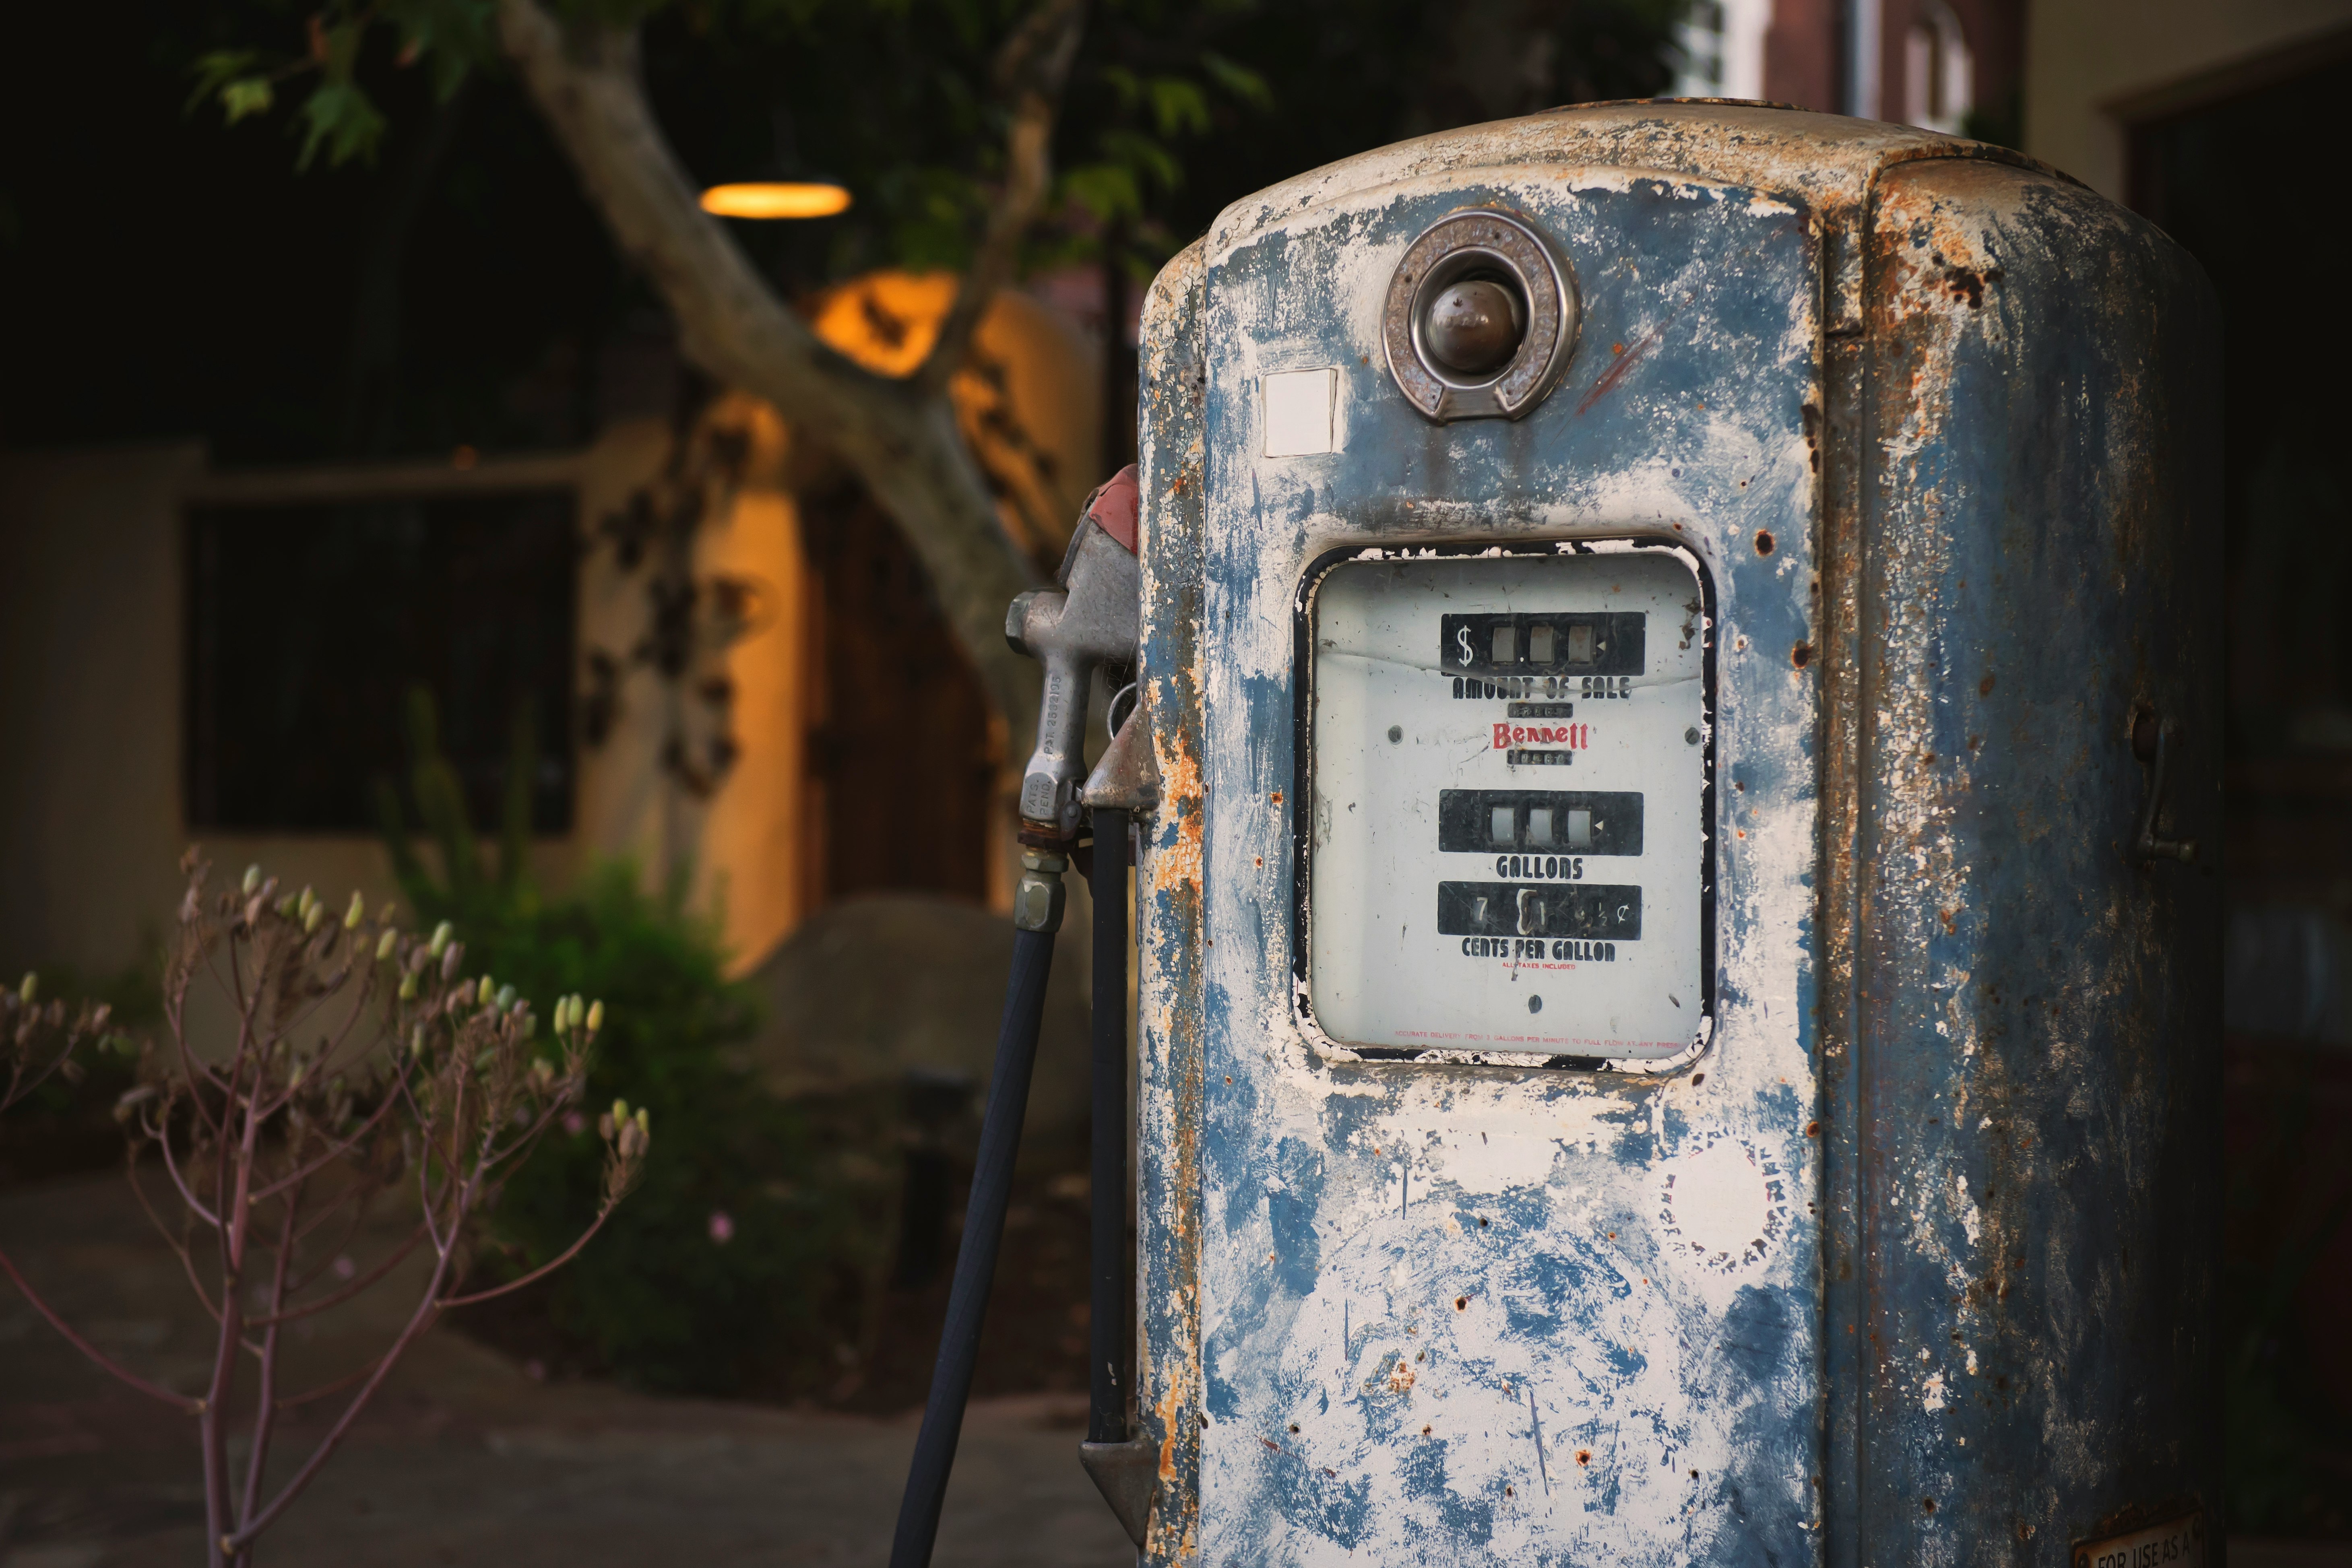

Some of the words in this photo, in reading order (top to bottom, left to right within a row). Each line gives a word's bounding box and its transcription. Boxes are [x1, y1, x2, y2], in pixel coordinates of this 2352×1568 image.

[1457, 625, 1473, 667] $
[1453, 677, 1534, 699] AMOUNT
[1545, 677, 1569, 699] OF
[1582, 677, 1630, 699] SALE
[1044, 731, 1055, 755] PAT.
[1493, 722, 1588, 750] Bennett
[1027, 780, 1039, 813] PATS.
[1040, 781, 1051, 815] PEND.
[1496, 856, 1583, 879] GALLONS
[1476, 897, 1488, 921] 7
[1462, 937, 1509, 957] CENTS
[1515, 939, 1545, 959] PER
[1552, 940, 1615, 962] GALLON
[2098, 1552, 2127, 1568] FOR
[2133, 1542, 2158, 1568] USE
[2162, 1535, 2178, 1564] AS
[2182, 1531, 2190, 1556] A
